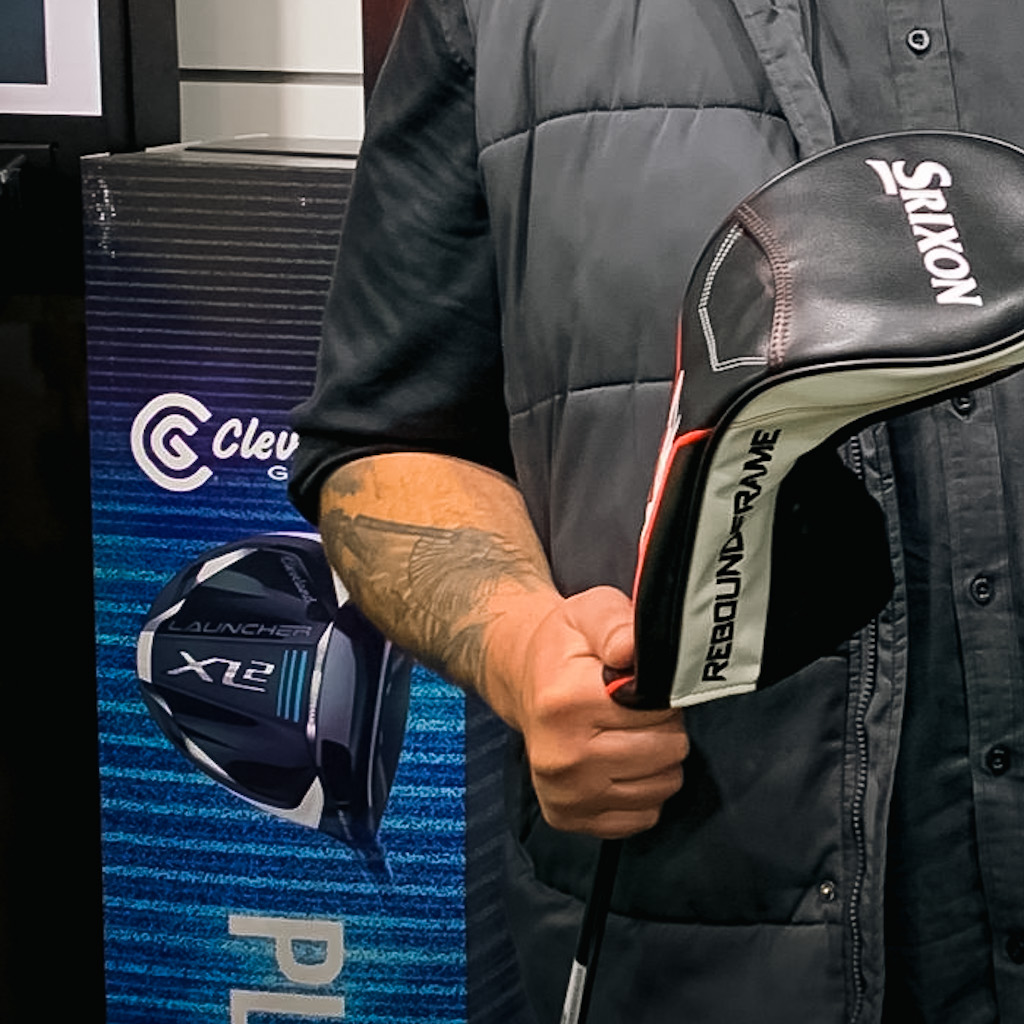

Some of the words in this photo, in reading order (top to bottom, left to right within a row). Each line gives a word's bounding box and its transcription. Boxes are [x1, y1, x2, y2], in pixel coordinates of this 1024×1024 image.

[890, 160, 984, 307] SRIXON
[168, 619, 312, 637] LAUNCHER
[228, 915, 345, 1024] PL
